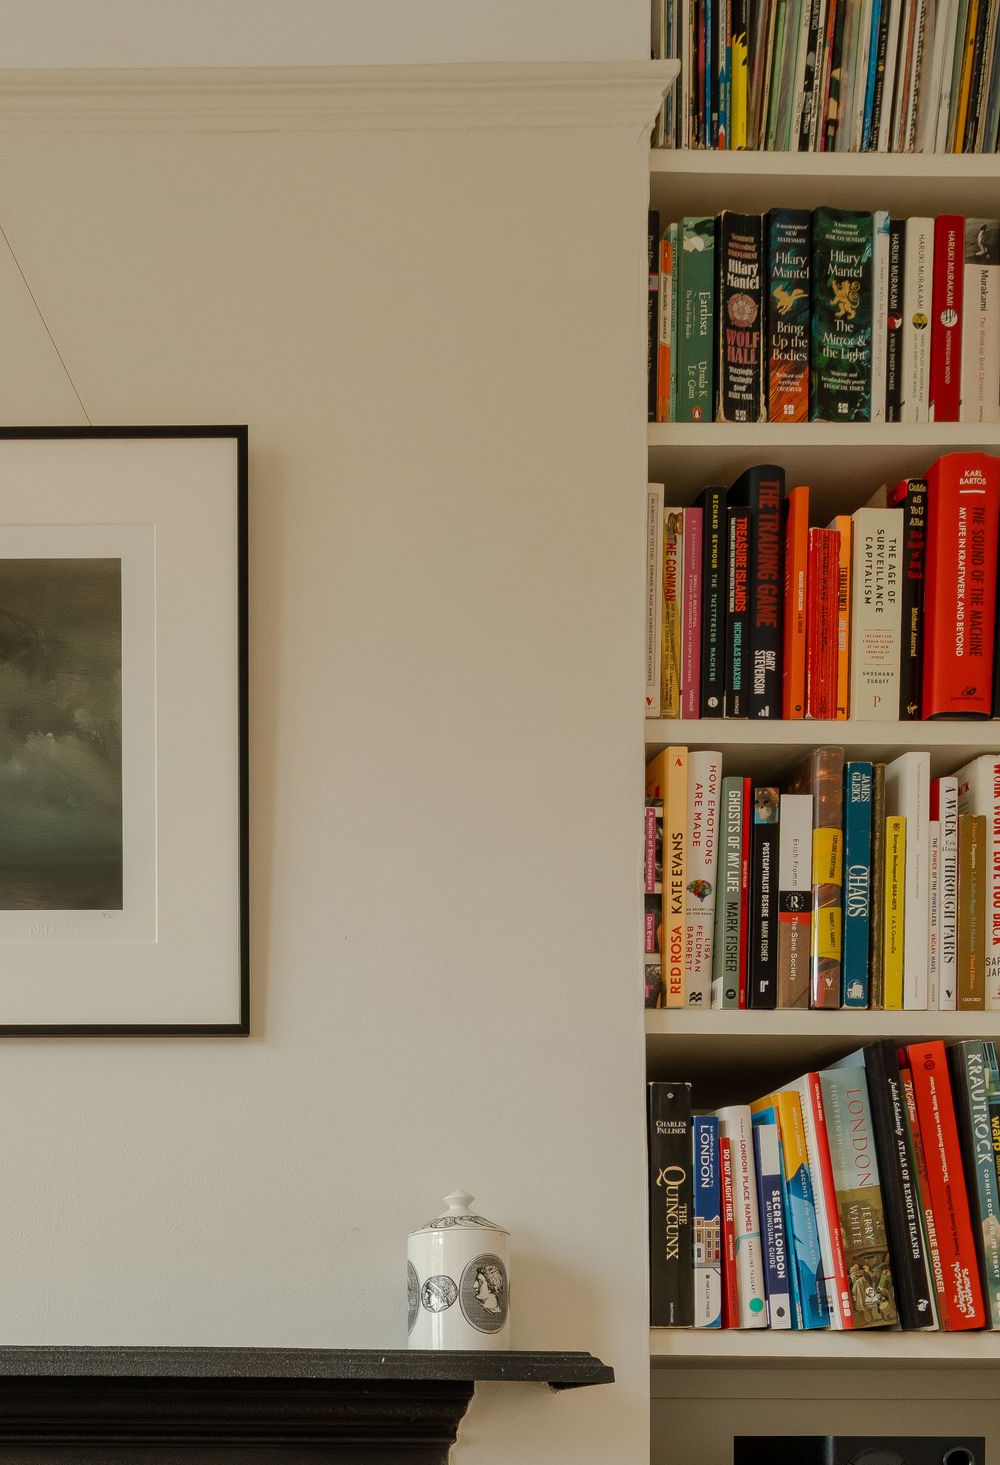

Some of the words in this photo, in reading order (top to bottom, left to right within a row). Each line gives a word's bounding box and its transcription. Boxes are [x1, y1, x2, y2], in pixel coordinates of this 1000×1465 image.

[776, 251, 807, 268] Hilary
[831, 249, 860, 266] Hilary
[891, 233, 900, 265] HARUKI
[918, 234, 926, 265] HARUKI
[727, 273, 759, 289] Mantel
[728, 259, 759, 277] Hilary
[772, 266, 809, 279] Mantel
[827, 264, 862, 278] Mantel
[946, 261, 954, 306] MURAKAMI
[889, 265, 898, 309] MURAKAMI
[980, 269, 989, 311] Murakami
[726, 328, 759, 347] WOLF
[772, 335, 787, 349] Up
[791, 336, 808, 347] the
[777, 321, 804, 336] Bring
[834, 319, 853, 332] The
[773, 349, 808, 361] Bodies
[823, 348, 838, 358] the
[841, 348, 866, 362] Light
[759, 481, 779, 509] THE
[958, 522, 966, 536] LIFE
[959, 507, 966, 520] MY
[758, 511, 779, 581] TRADING
[971, 530, 984, 565] SOUND
[864, 537, 873, 604] CAPITALISM
[875, 530, 885, 613] SURVEILLANCE
[888, 564, 896, 585] AGE
[957, 549, 966, 599] KRAFTWERK
[735, 572, 746, 612] ISLANDS
[757, 584, 778, 628] GAME
[887, 591, 895, 603] OF
[733, 622, 742, 653] NICHOLAS
[955, 622, 964, 656] BEYOND
[969, 611, 983, 656] MACHINE
[733, 655, 742, 690] SHAXSON
[754, 650, 765, 694] STEVENSON
[766, 650, 776, 671] GARY
[694, 783, 703, 807] ARE
[861, 774, 870, 802] JAMES
[728, 790, 740, 833] GHOSTS
[944, 799, 957, 836] WALK
[693, 813, 702, 847] MADE
[705, 800, 715, 865] EMOTIONS
[728, 837, 740, 849] OF
[672, 832, 683, 877] EVANS
[728, 853, 740, 872] MY
[671, 880, 682, 914] KATE
[727, 872, 739, 893] LIFE
[848, 864, 869, 917] CHAOS
[944, 855, 957, 920] THROUGH
[726, 902, 738, 932] MARK
[761, 895, 769, 917] DESIRE
[671, 926, 682, 963] ROSA
[685, 926, 693, 971] BARRETT
[695, 925, 703, 972] FELDMAN
[726, 936, 737, 972] FISHER
[761, 940, 769, 962] FISHER
[943, 928, 956, 964] PARIS
[670, 967, 681, 994] RED
[789, 955, 797, 982] Society
[967, 1053, 992, 1165] KRAUTROCK
[845, 1088, 873, 1187] LONDON
[991, 1116, 1000, 1151] warp
[700, 1125, 710, 1188] LONDON
[723, 1149, 730, 1159] DO
[897, 1140, 909, 1168] ATLAS
[656, 1164, 686, 1259] QUINCUNX
[678, 1200, 687, 1224] THE
[771, 1190, 781, 1228] SECRET
[903, 1183, 915, 1220] REMOTE
[850, 1205, 862, 1246] WHITE
[861, 1206, 874, 1241] JERRY
[908, 1222, 921, 1259] ISLANDS
[774, 1230, 785, 1279] LONDON
[925, 1209, 937, 1247] CHARLIE
[931, 1249, 945, 1293] BROOKER
